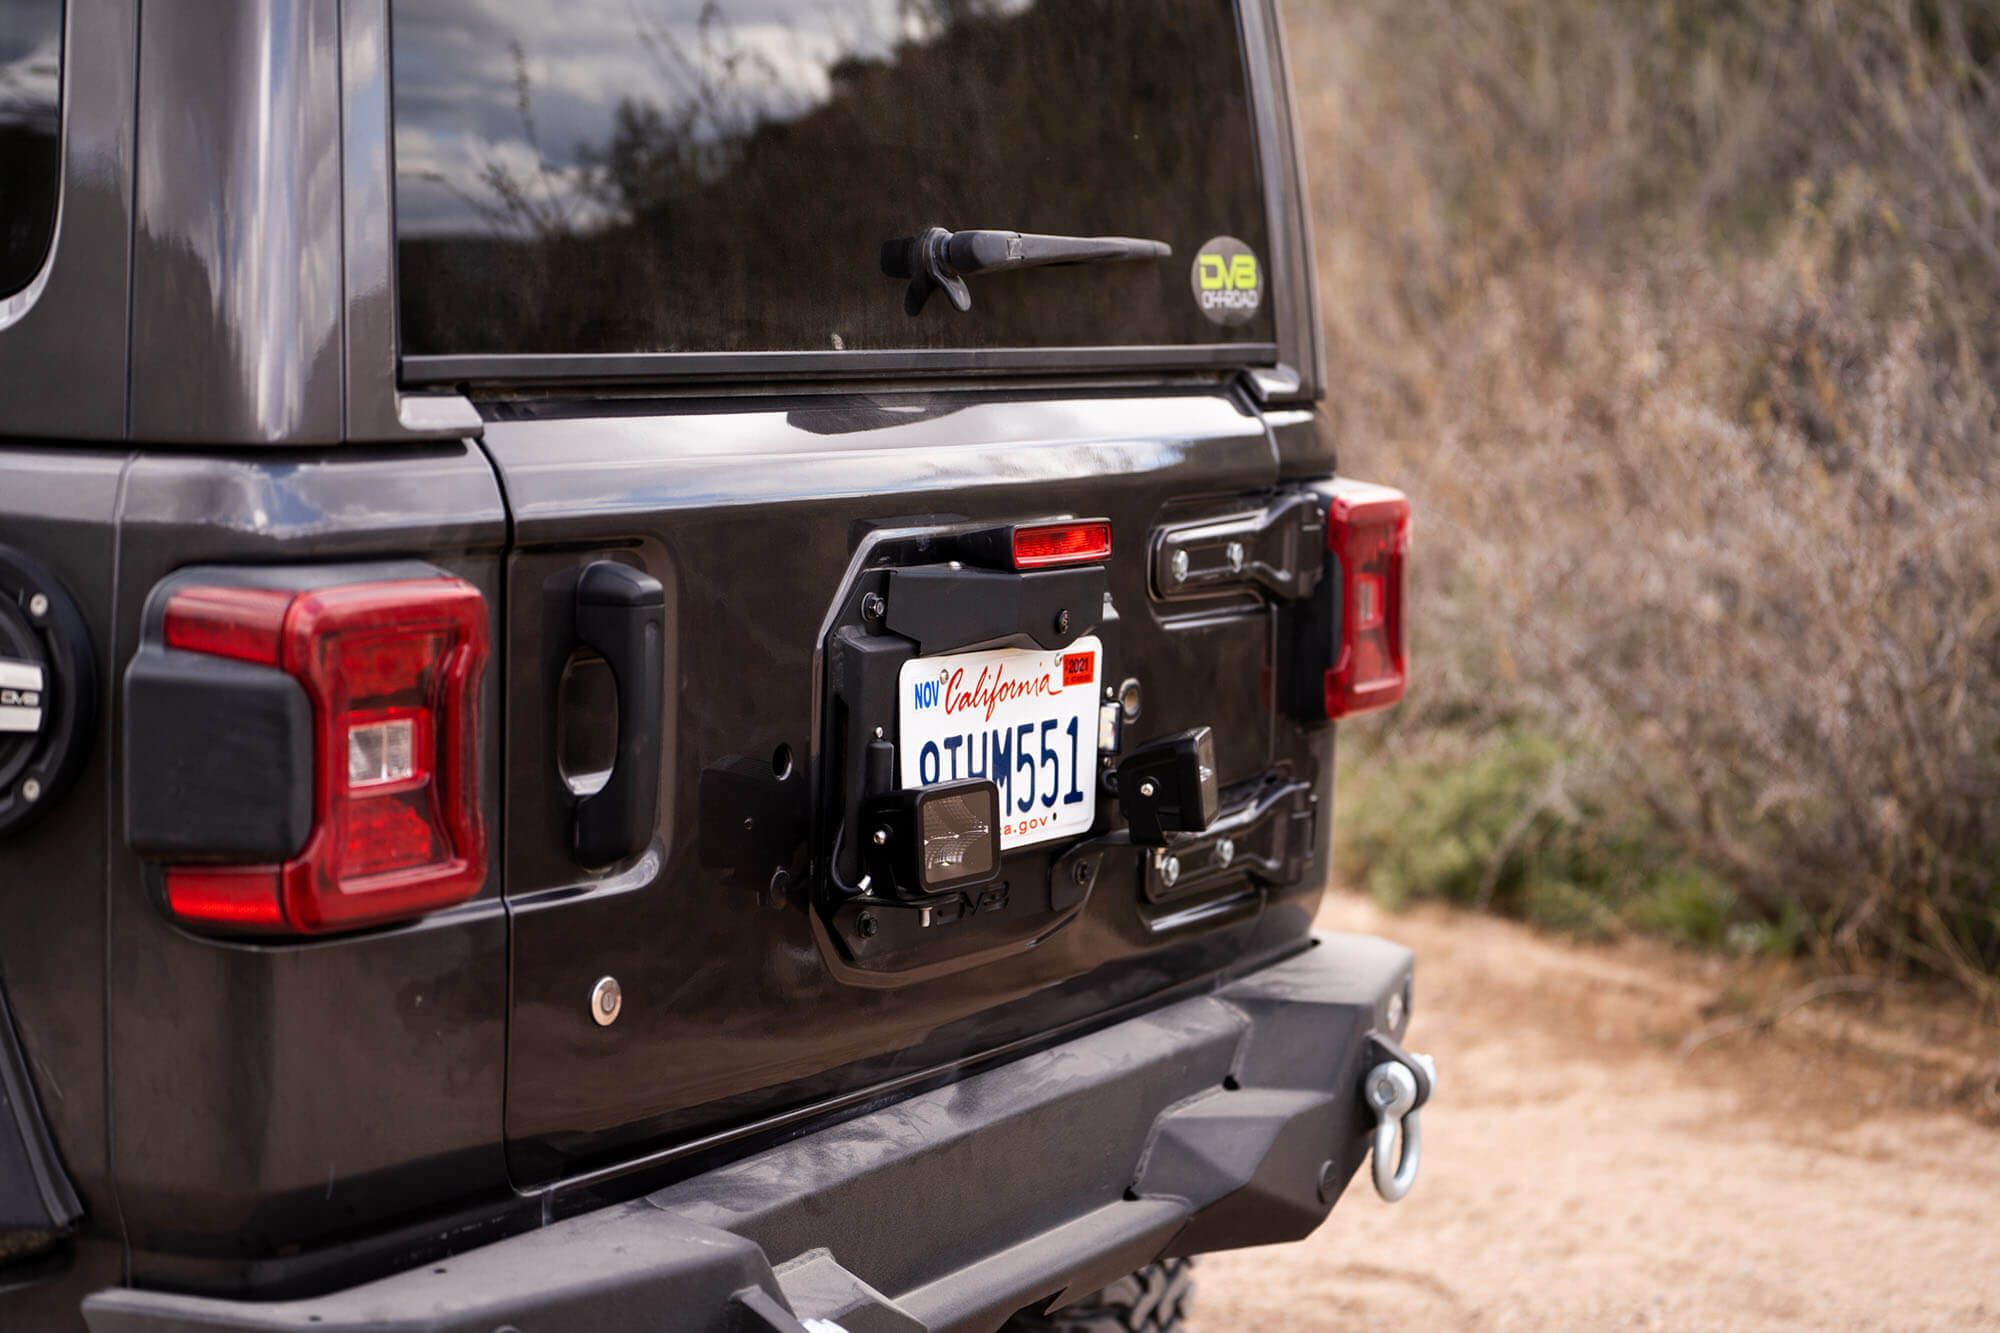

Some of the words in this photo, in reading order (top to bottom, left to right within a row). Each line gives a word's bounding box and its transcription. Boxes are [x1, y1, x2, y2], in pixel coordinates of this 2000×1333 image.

[1199, 254, 1257, 290] DV8
[1068, 656, 1089, 674] 2021
[914, 681, 939, 710] NOV
[945, 662, 1062, 722] California
[1000, 816, 1048, 836] a.gov
